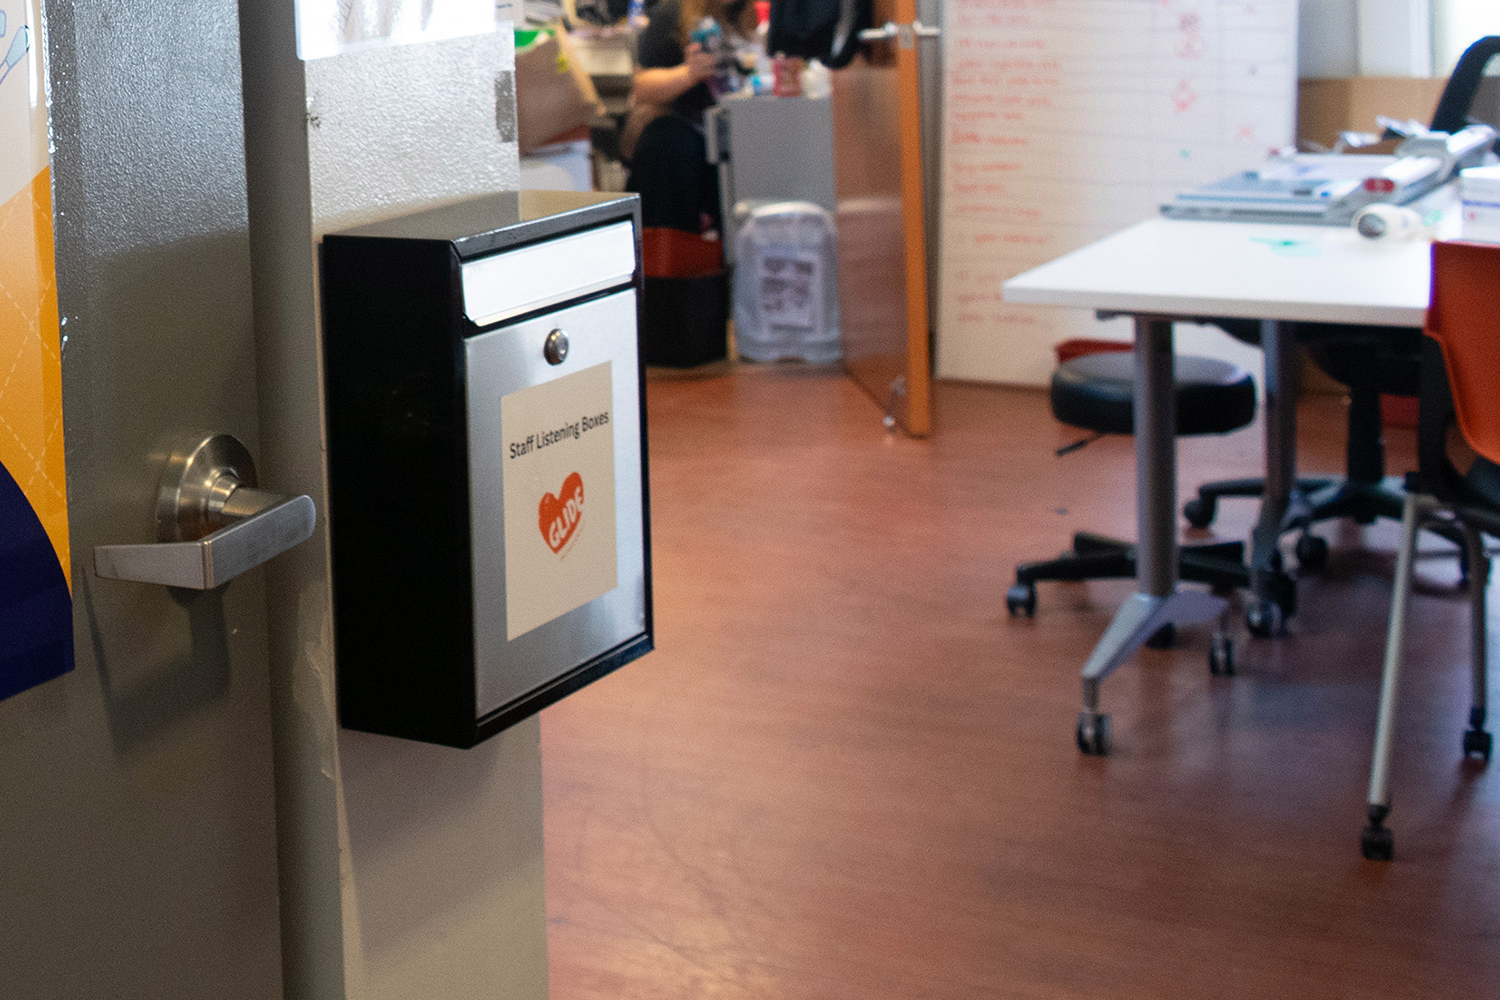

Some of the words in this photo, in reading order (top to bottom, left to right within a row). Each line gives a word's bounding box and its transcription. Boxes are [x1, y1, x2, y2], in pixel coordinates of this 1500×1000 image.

[510, 434, 534, 460] Staff
[536, 421, 580, 450] Listening
[582, 411, 610, 432] Boxes
[549, 485, 584, 549] GLIDE
